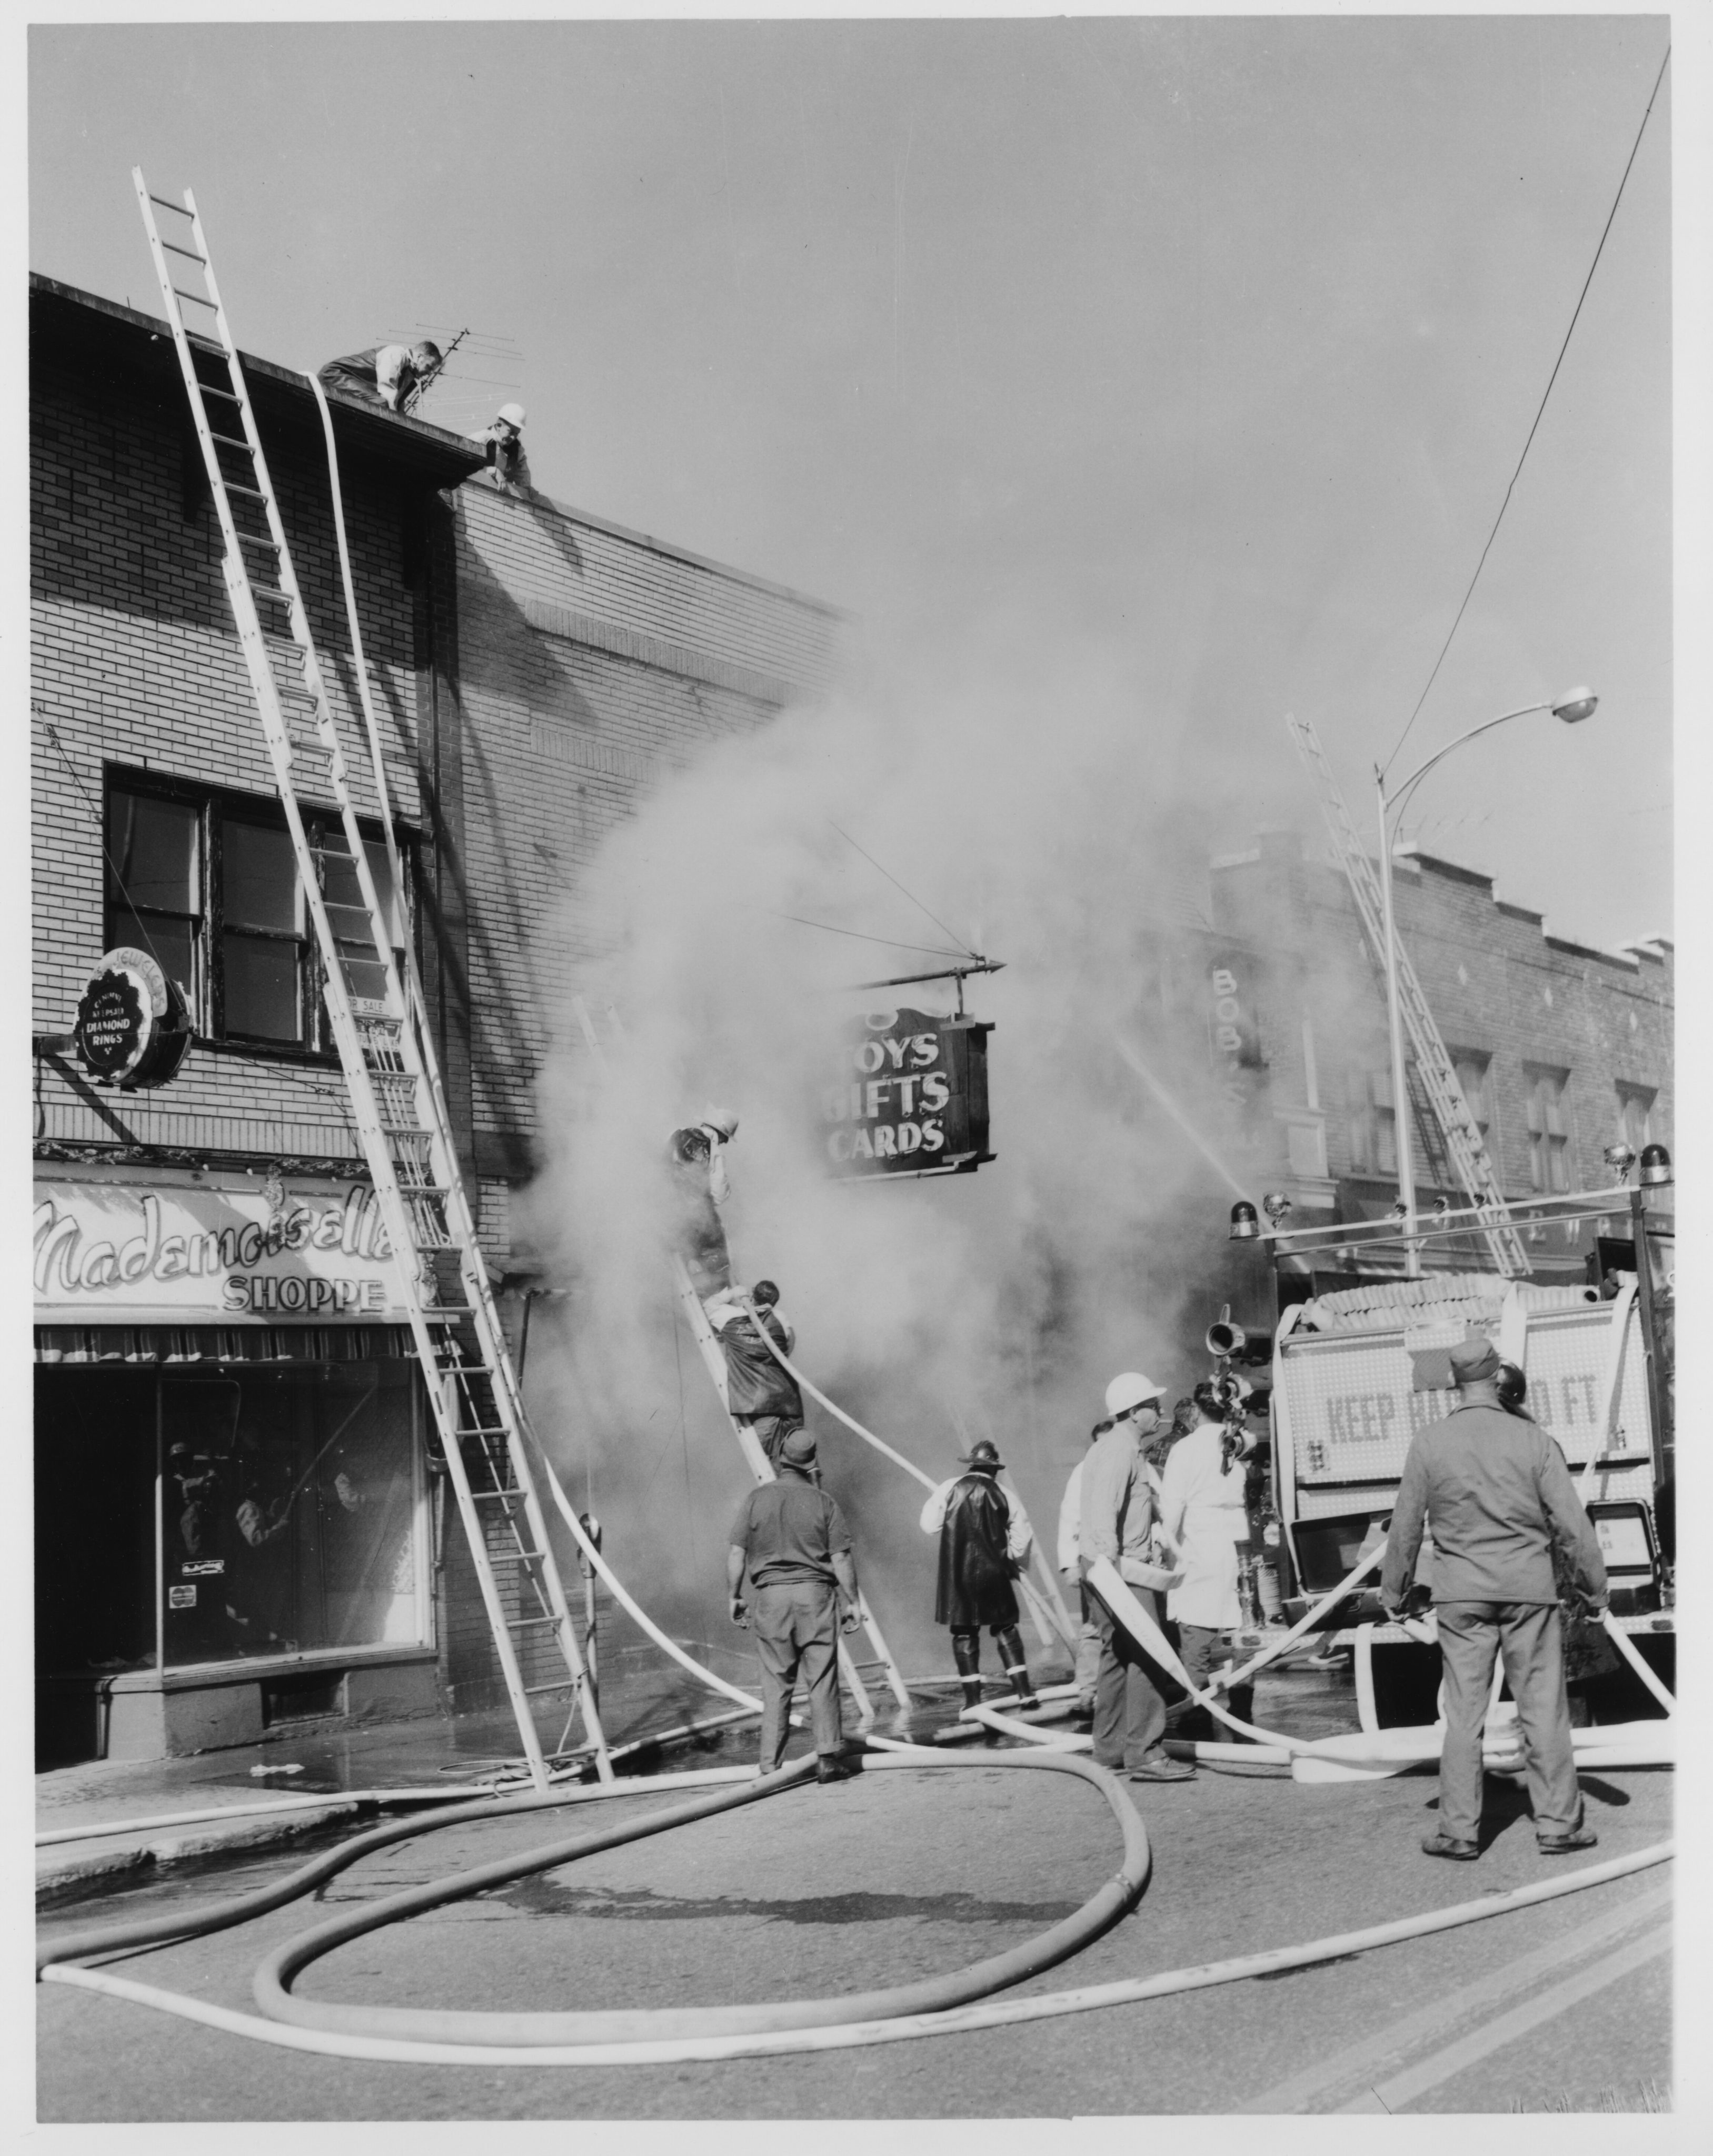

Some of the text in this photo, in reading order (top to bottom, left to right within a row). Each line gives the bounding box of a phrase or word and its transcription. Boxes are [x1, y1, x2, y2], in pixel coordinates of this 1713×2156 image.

[363, 1000, 383, 1013] SALE
[86, 1018, 131, 1033] DIAMOND
[93, 1034, 123, 1046] RINGS
[849, 1032, 939, 1074] OYS
[828, 1118, 945, 1162] CARDS
[222, 1275, 385, 1311] SHOPPE
[1327, 1392, 1396, 1444] KEEP
[1561, 1375, 1596, 1425] FT
